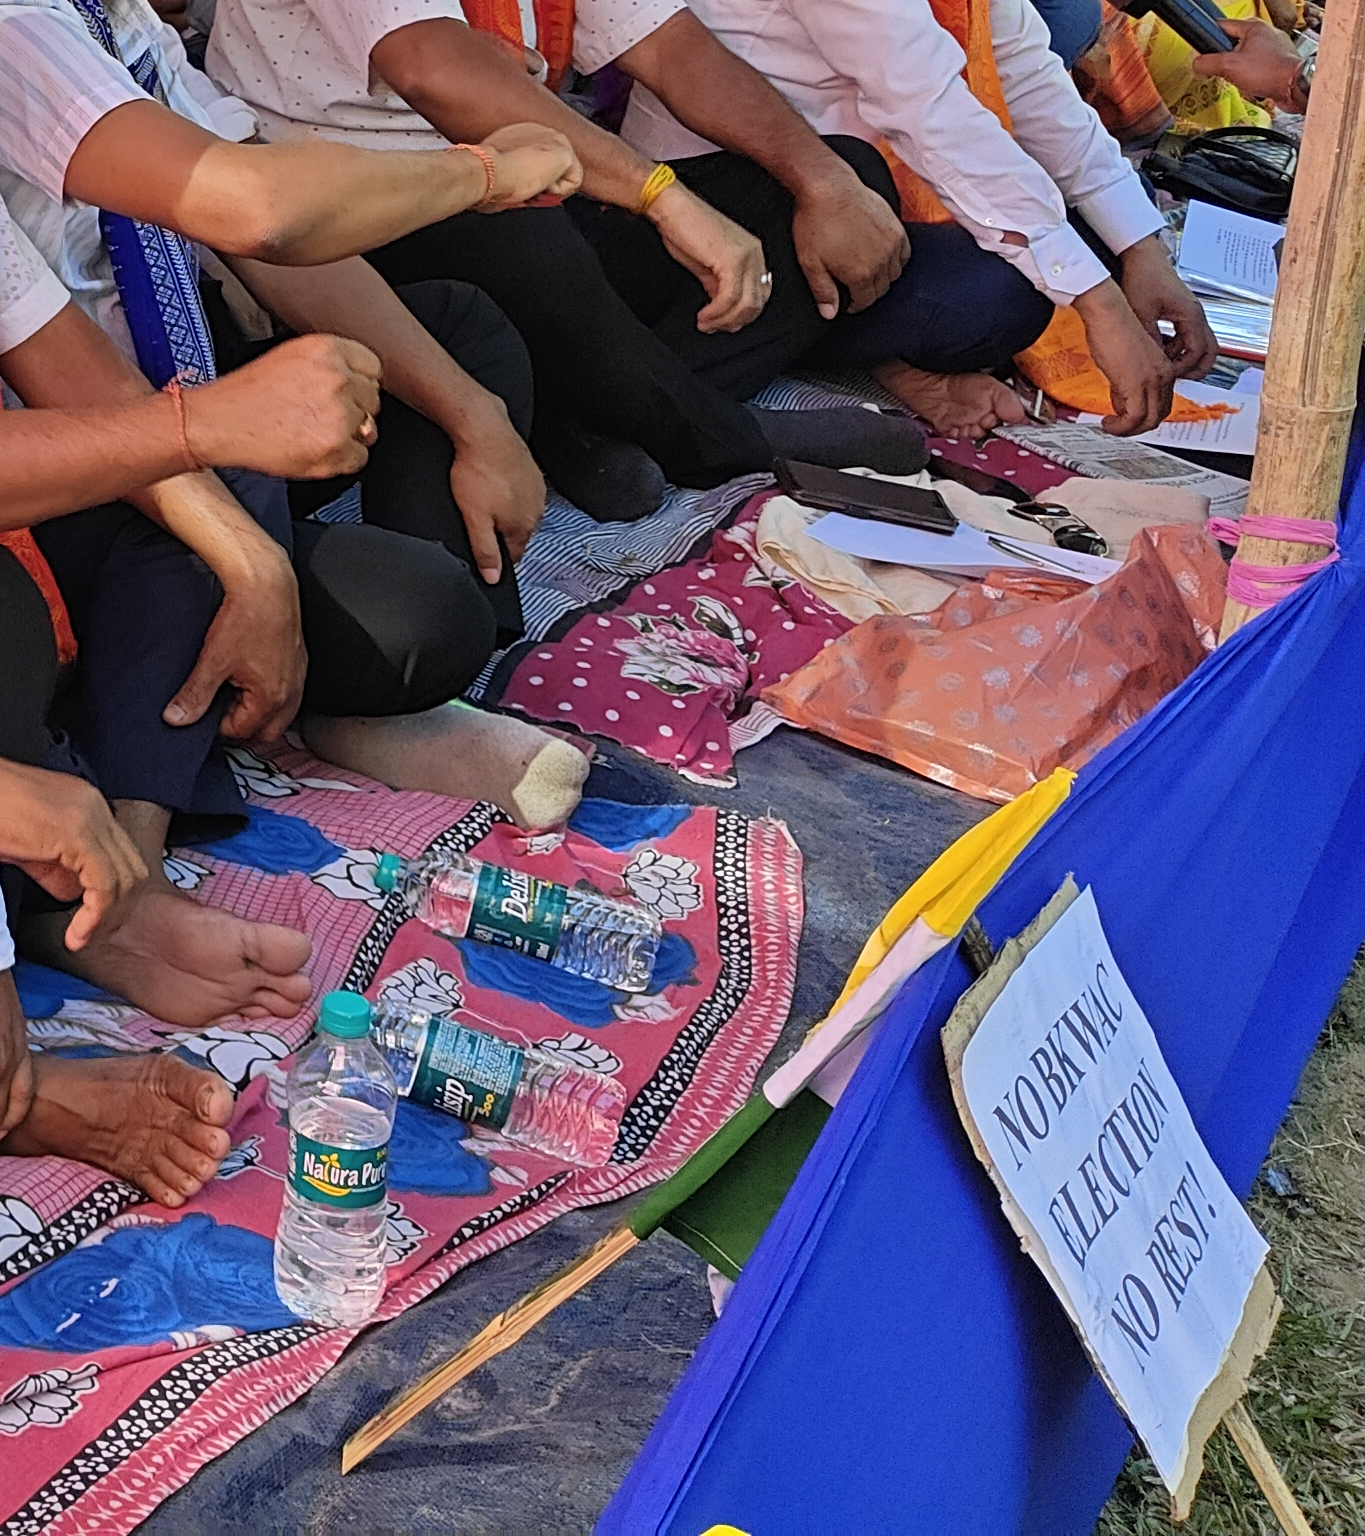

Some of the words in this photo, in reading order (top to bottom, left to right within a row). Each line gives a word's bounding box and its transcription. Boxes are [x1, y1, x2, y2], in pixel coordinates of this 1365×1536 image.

[991, 1091, 1048, 1171] NO
[1027, 959, 1123, 1116] BKWAC
[303, 1151, 359, 1187] Natura
[1047, 1057, 1169, 1272] ELECTION
[1109, 1272, 1161, 1374] NO
